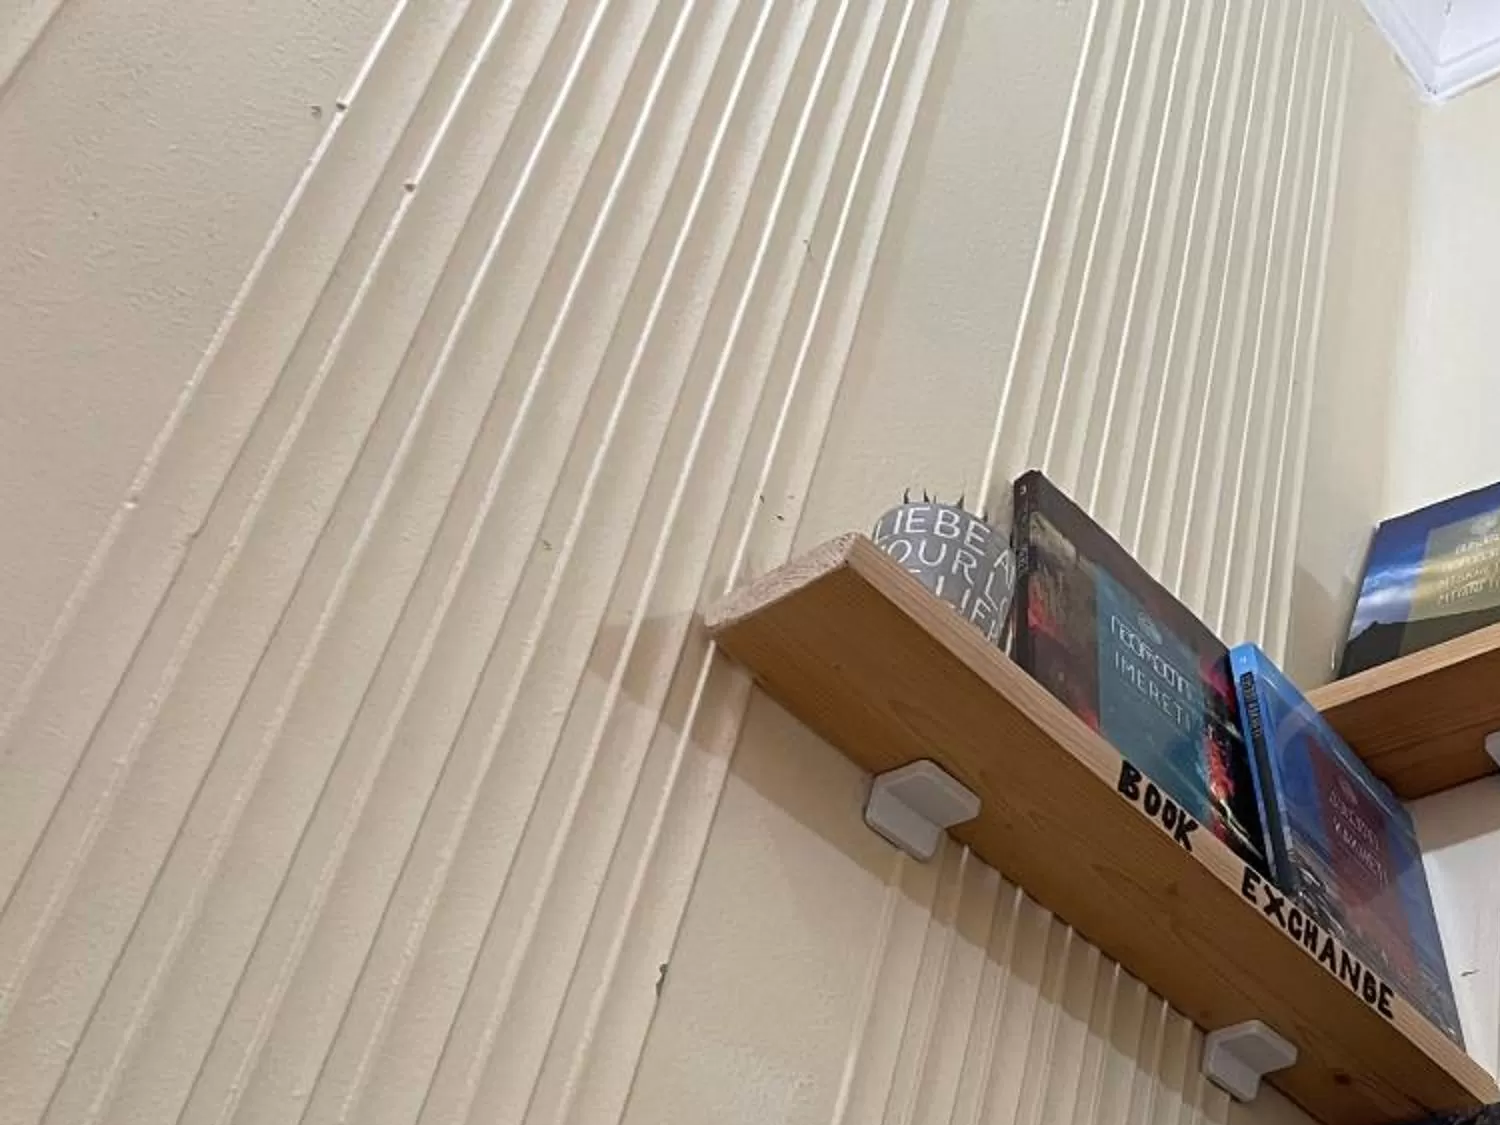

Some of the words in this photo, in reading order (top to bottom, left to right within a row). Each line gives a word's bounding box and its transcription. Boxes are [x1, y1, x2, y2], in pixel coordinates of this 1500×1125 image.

[1115, 651, 1191, 733] IMERETI
[1117, 759, 1199, 851] BOOK
[1241, 864, 1395, 1021] EXCHANGE
